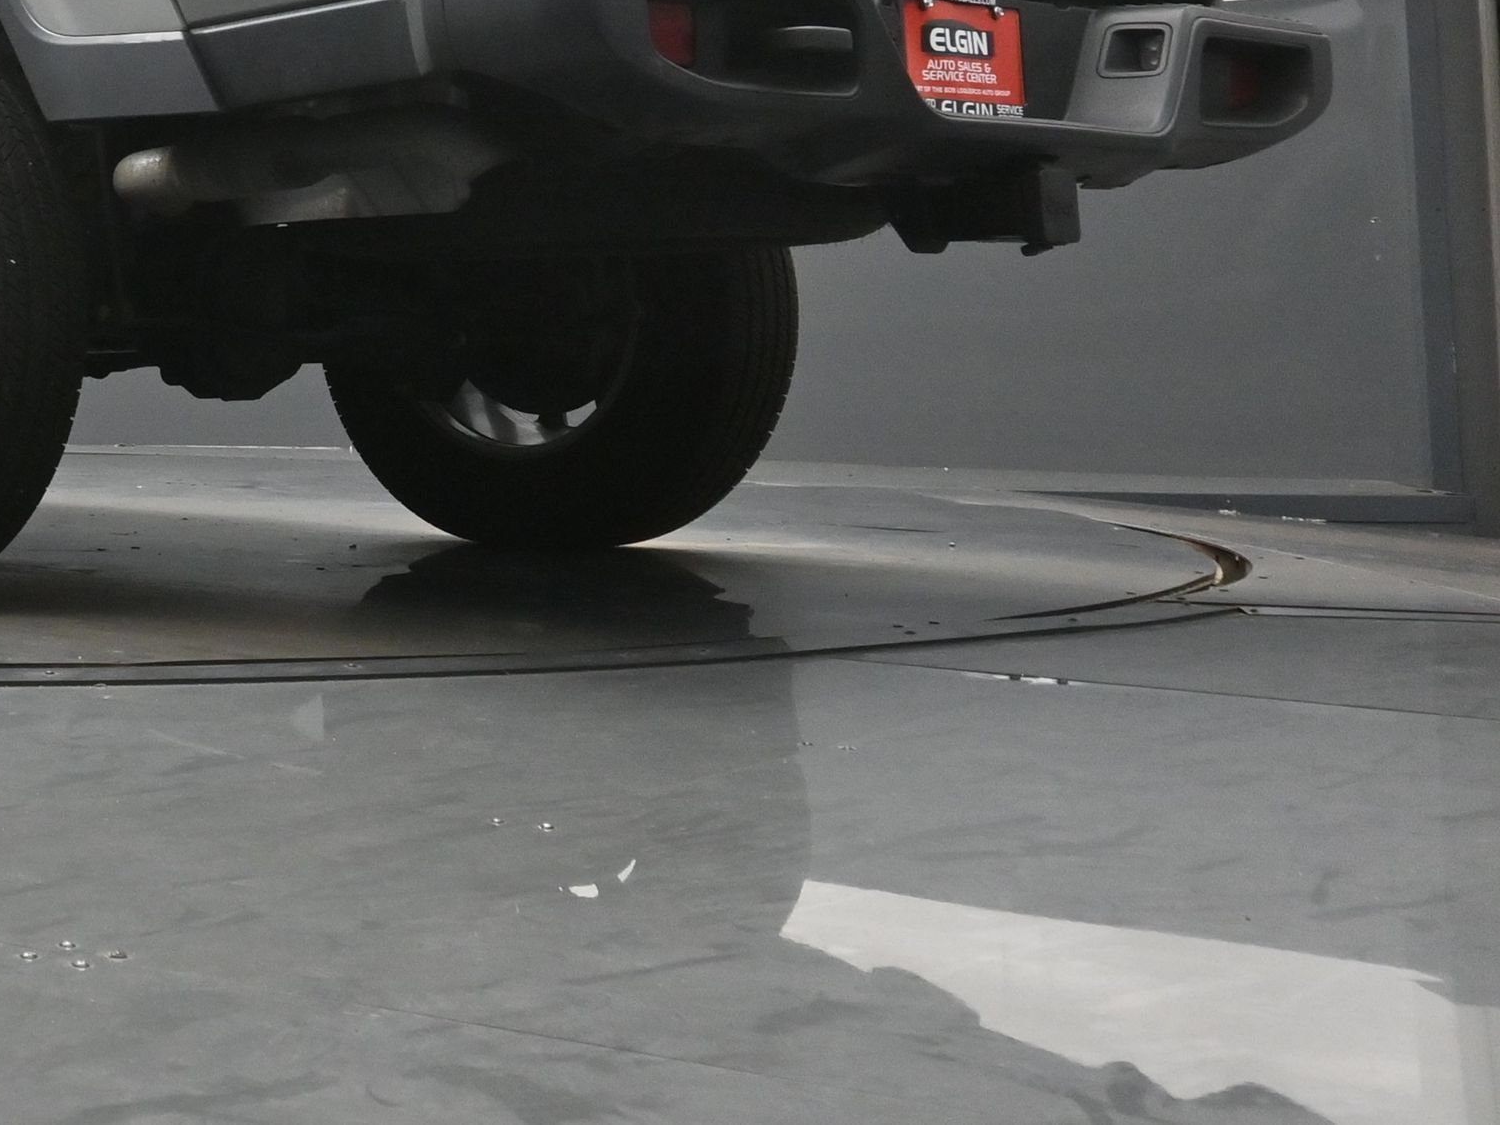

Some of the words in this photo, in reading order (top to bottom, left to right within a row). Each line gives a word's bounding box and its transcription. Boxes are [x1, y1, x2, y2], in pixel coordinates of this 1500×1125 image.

[929, 27, 989, 55] ELGIN
[927, 59, 956, 71] AUTO
[957, 61, 982, 73] SALES
[984, 63, 992, 73] &
[922, 70, 965, 83] SERVICE
[966, 73, 998, 84] CENTER
